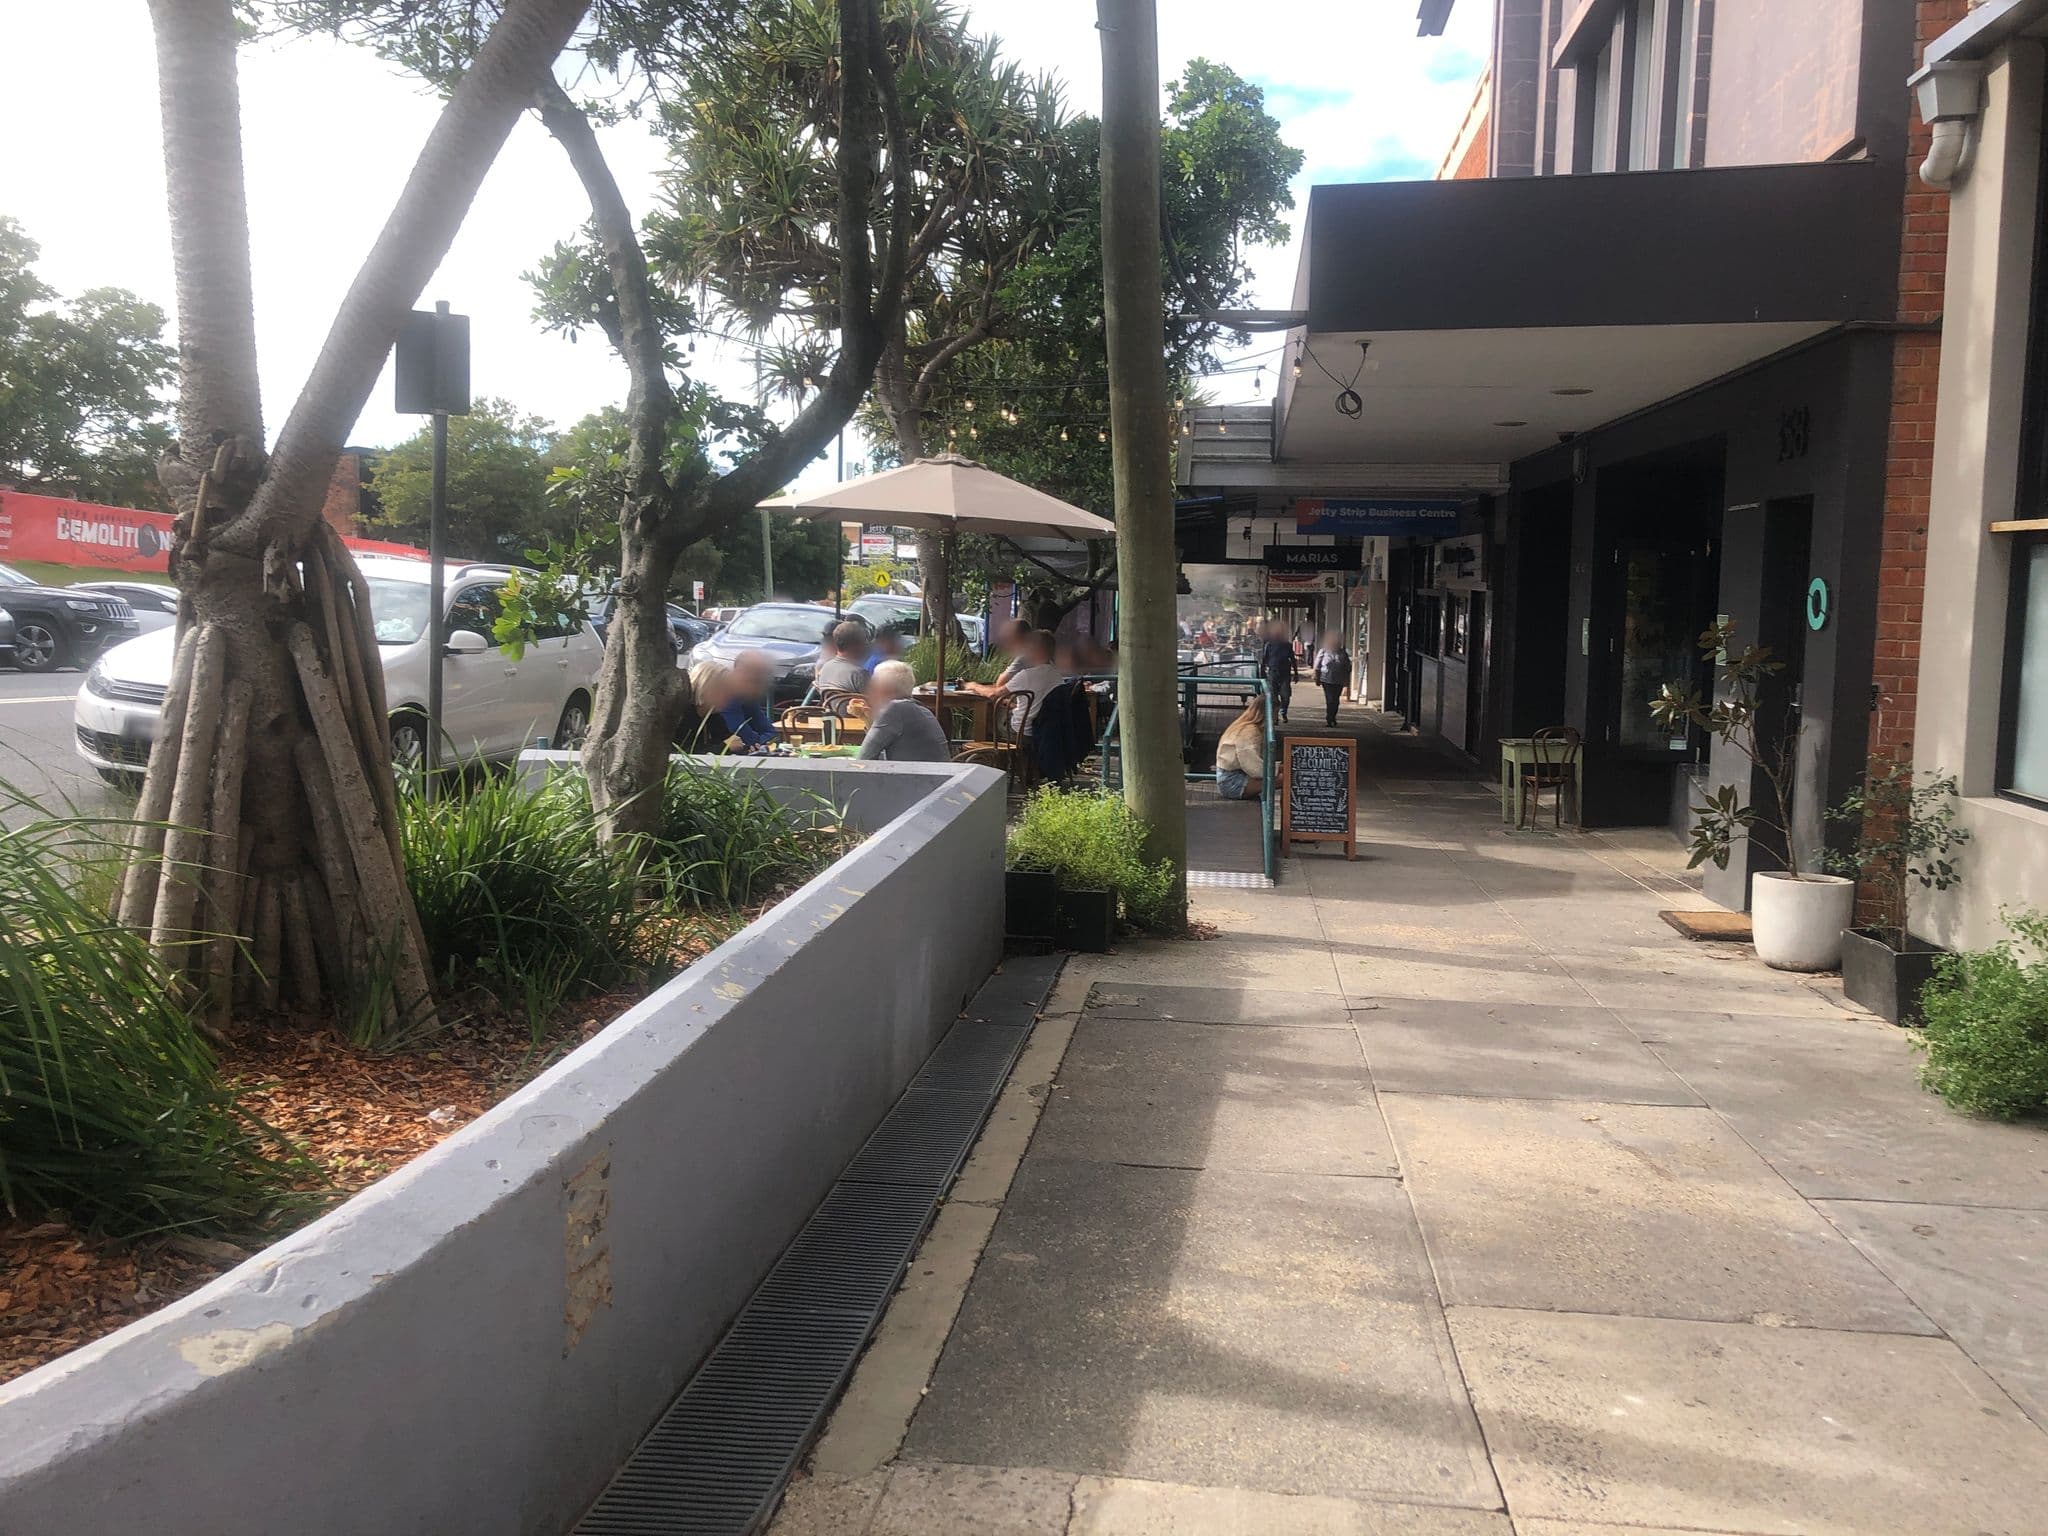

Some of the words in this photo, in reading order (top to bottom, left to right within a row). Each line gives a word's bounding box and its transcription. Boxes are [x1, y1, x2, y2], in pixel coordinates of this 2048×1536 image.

[1308, 507, 1337, 518] Jetty
[1340, 507, 1366, 518] Strip
[1368, 507, 1416, 518] Business
[1419, 508, 1457, 518] Centre
[1286, 553, 1338, 563] MARIAS
